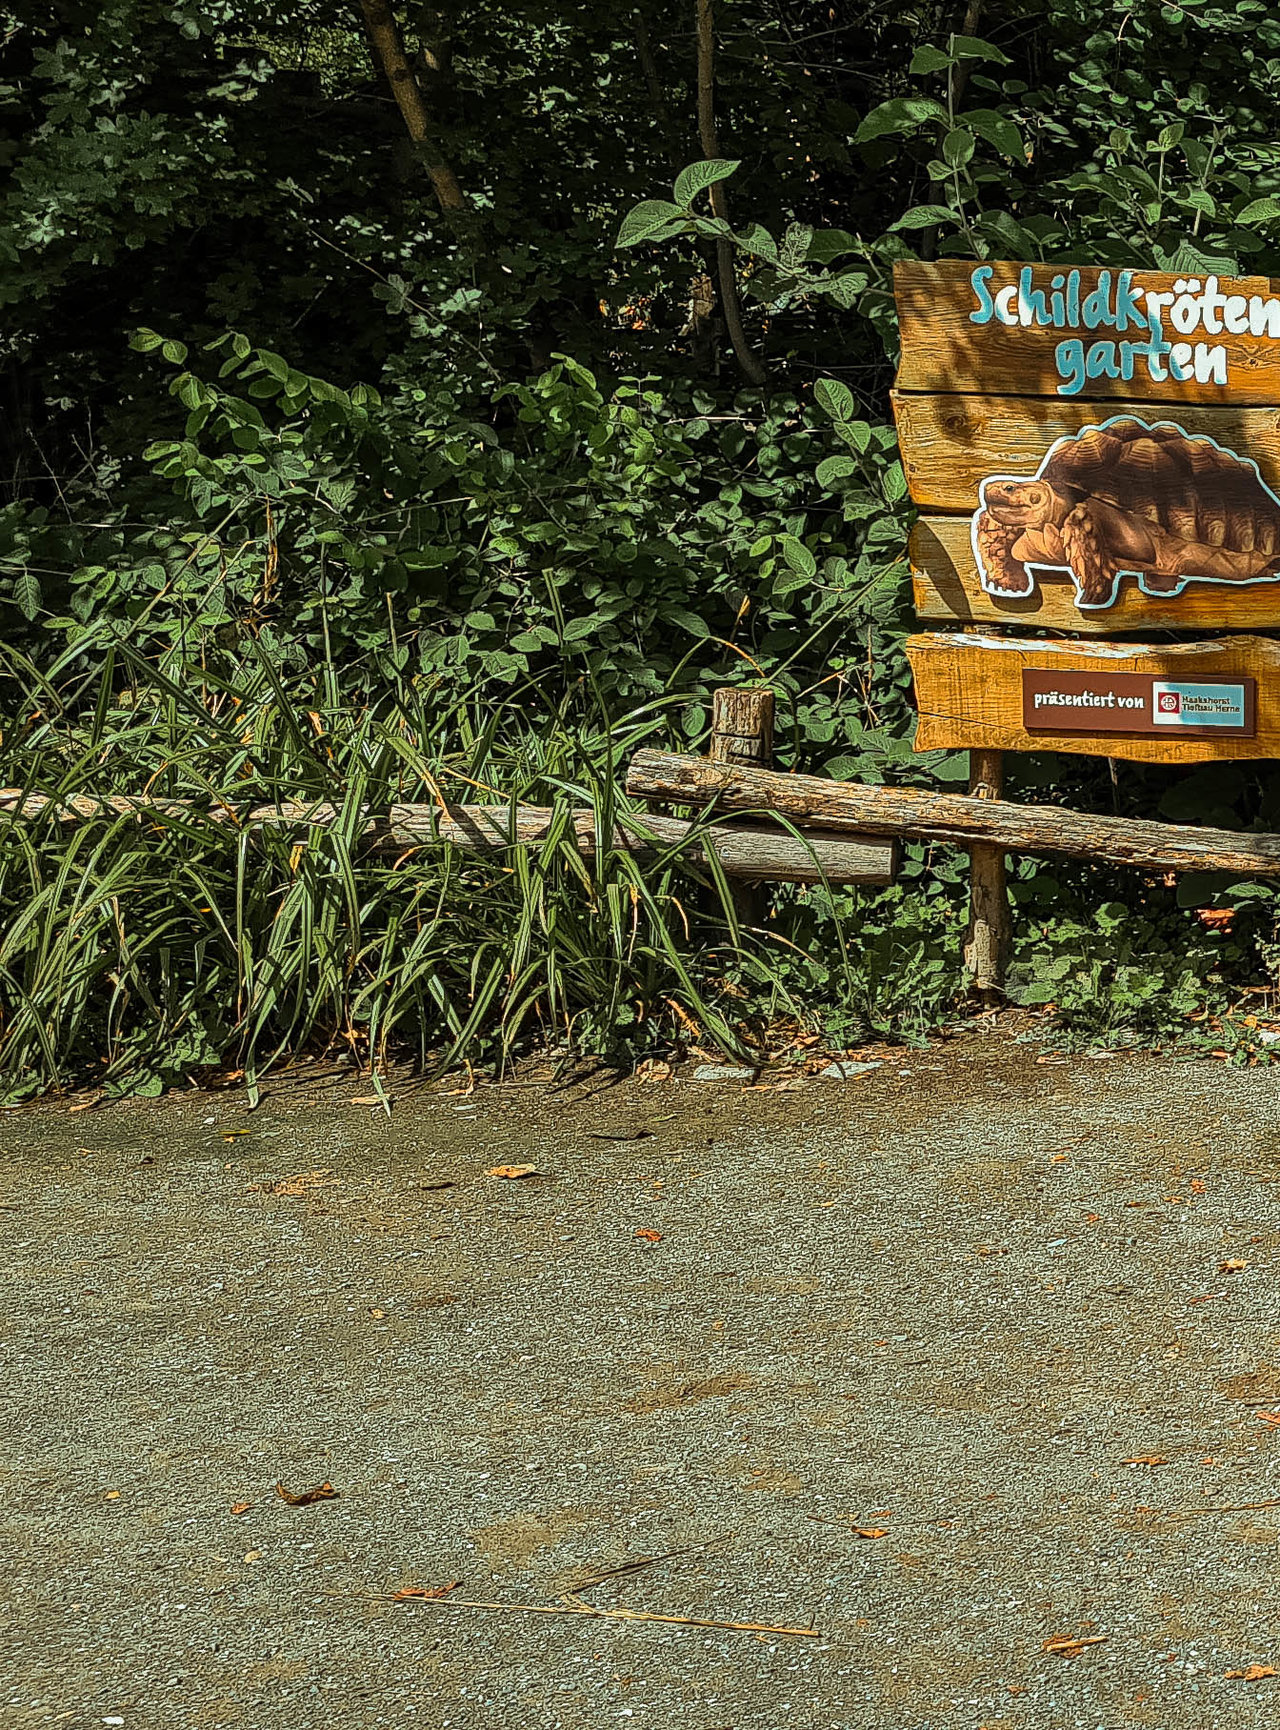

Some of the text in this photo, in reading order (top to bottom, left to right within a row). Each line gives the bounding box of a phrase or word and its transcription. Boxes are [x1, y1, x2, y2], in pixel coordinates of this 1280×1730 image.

[1054, 332, 1228, 395] garten
[1034, 690, 1115, 709] präsentiert
[1117, 697, 1144, 709] von
